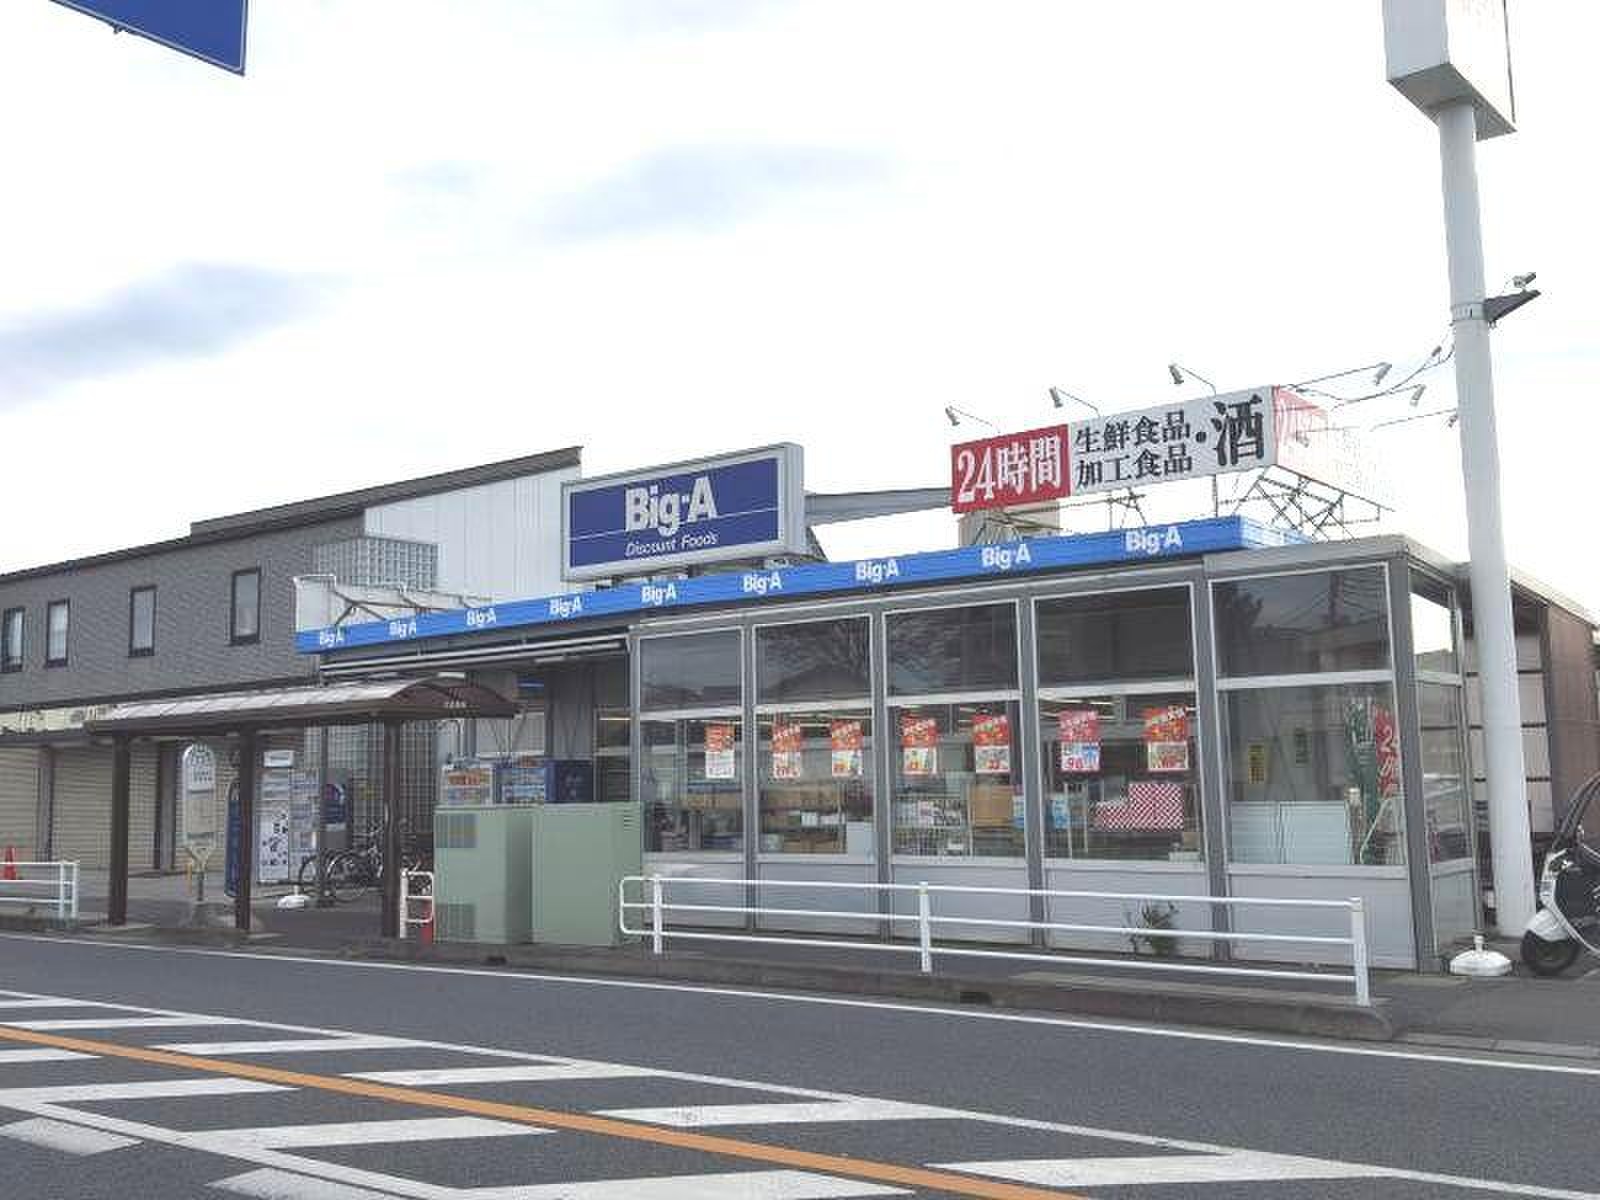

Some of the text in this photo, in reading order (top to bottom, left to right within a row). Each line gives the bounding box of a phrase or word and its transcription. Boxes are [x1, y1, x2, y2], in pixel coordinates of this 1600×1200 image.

[1075, 411, 1191, 454] 生鮮食品
[957, 434, 1062, 504] 24時間
[1076, 442, 1193, 488] 加工食品
